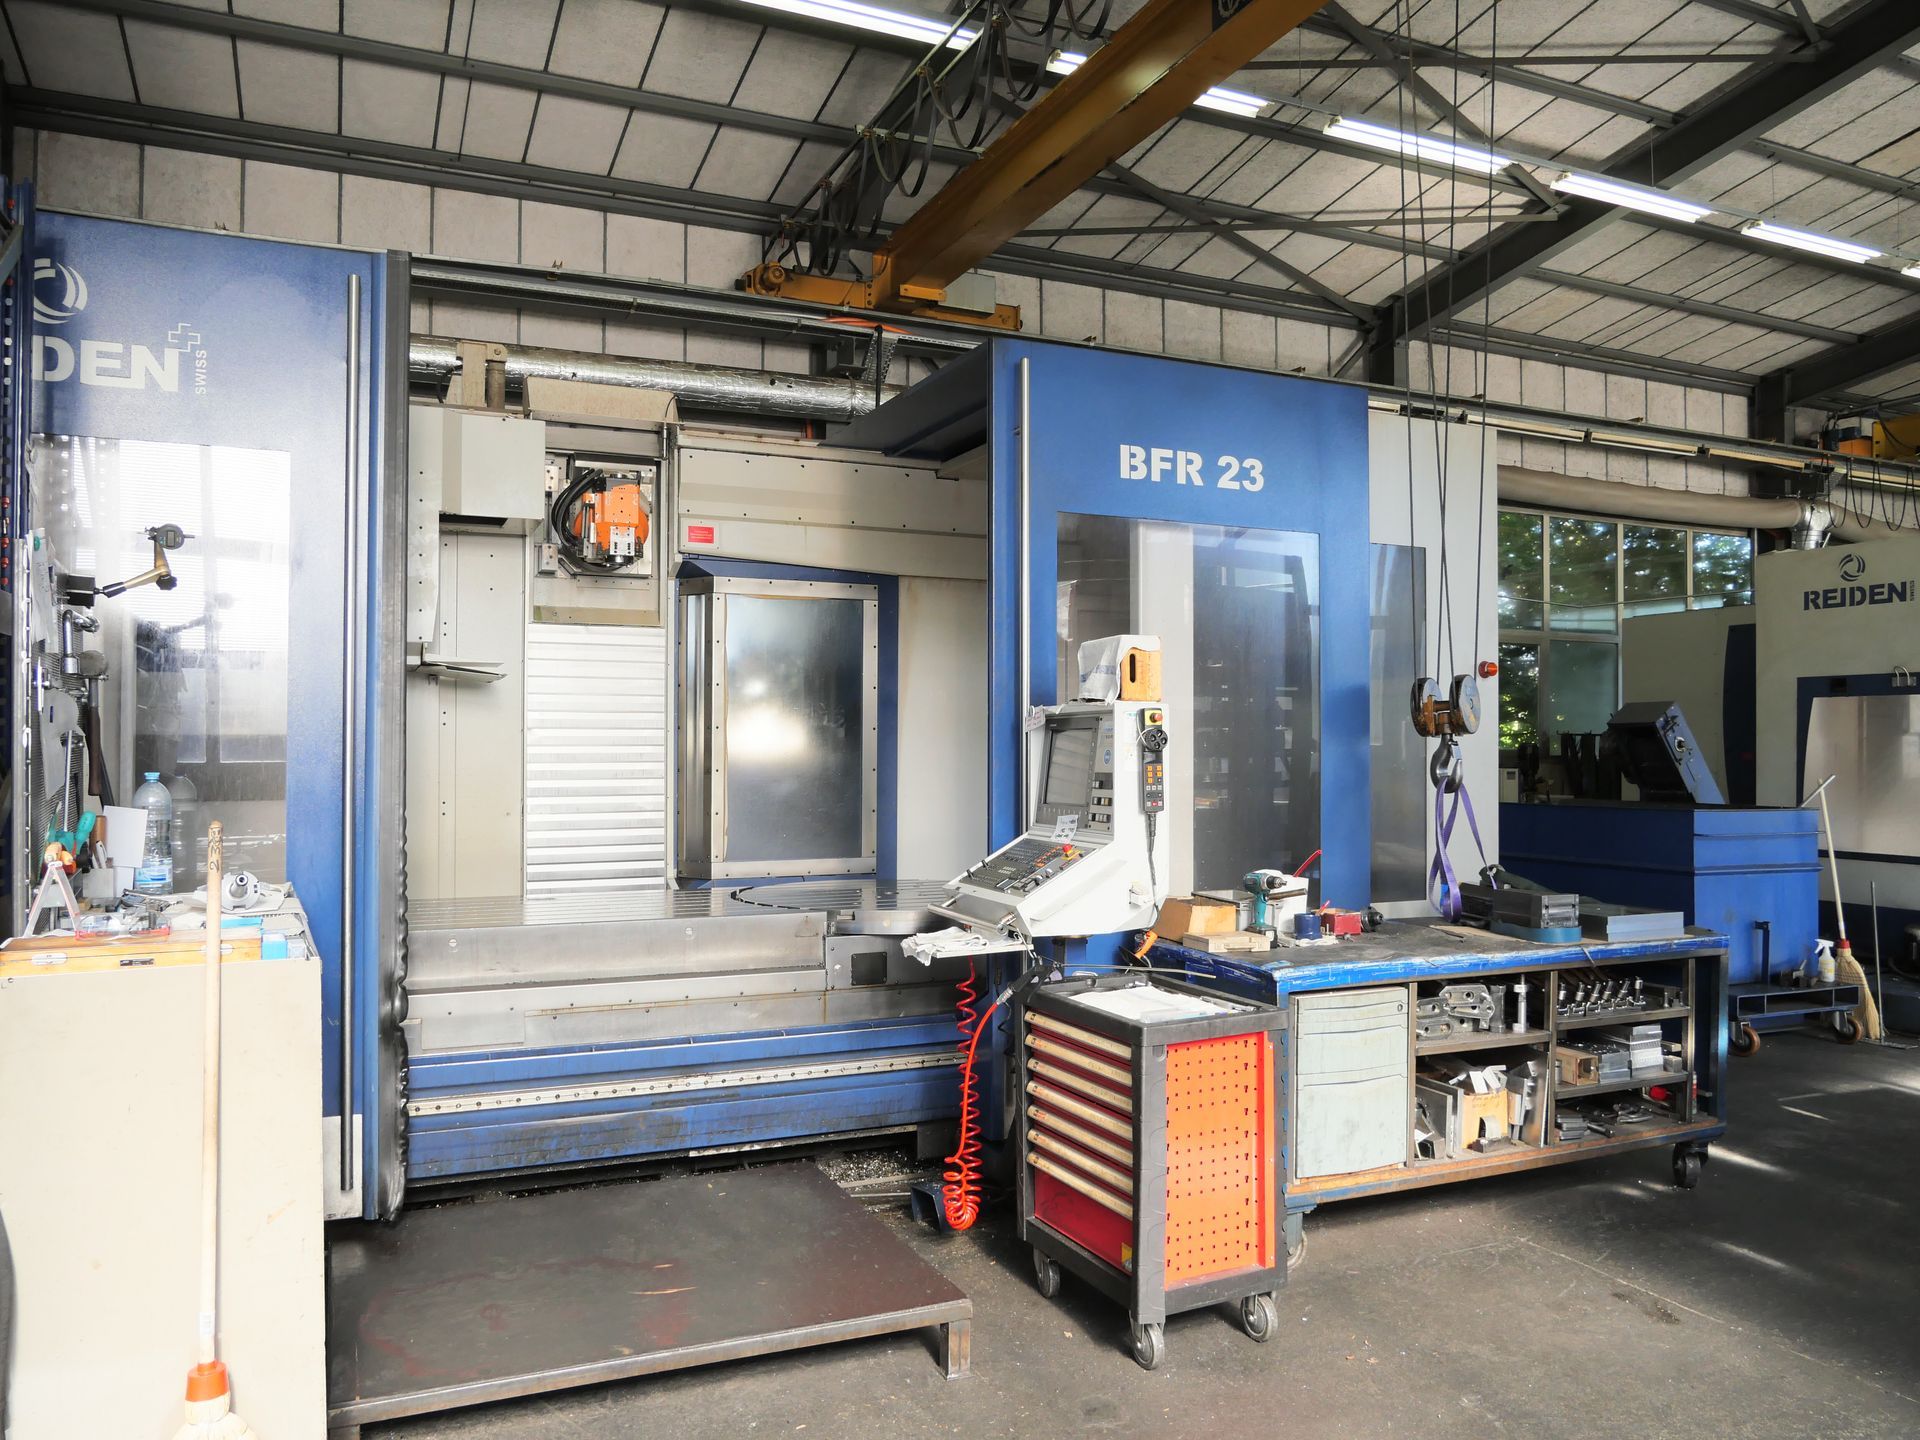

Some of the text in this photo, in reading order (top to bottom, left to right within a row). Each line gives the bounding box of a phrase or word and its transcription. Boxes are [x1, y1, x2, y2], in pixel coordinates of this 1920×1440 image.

[195, 350, 207, 395] SWISS
[1120, 444, 1265, 492] BFR 23
[1803, 581, 1907, 611] REIDEN
